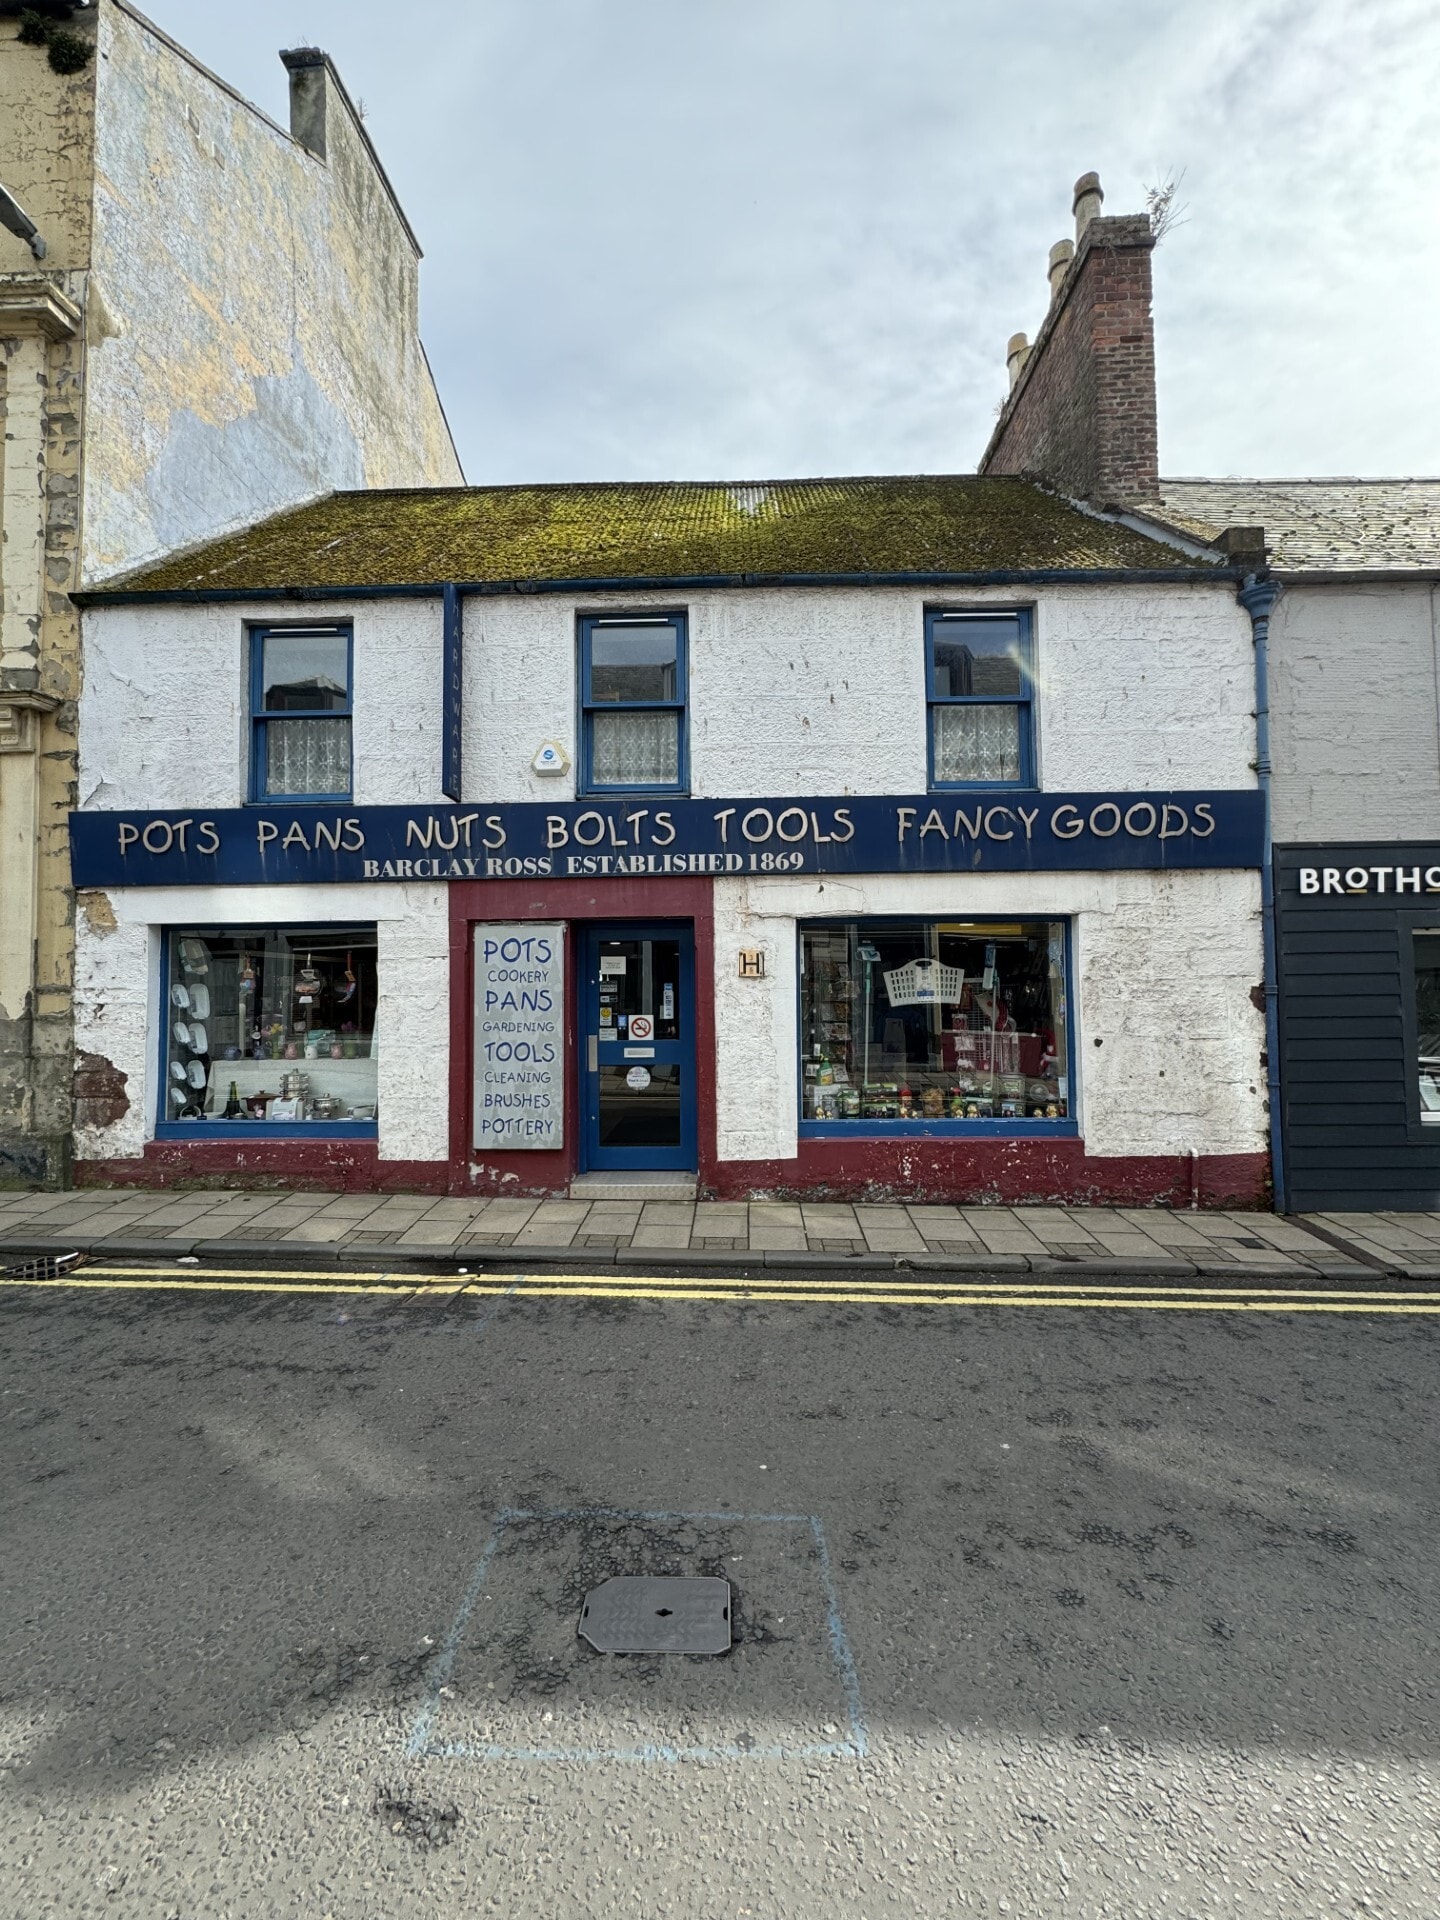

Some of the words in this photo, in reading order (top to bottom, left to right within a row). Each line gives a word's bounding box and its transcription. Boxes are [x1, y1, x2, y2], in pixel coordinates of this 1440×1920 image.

[452, 602, 460, 796] HARDWARE
[117, 819, 220, 855] POTS
[257, 818, 365, 853] PANS
[406, 813, 507, 850] NUTS
[547, 809, 676, 849] BOLTS
[713, 808, 855, 843] TOOLS
[897, 806, 1039, 842] FANCY
[1050, 802, 1215, 839] GOODS
[363, 859, 479, 877] BARCLAY
[486, 856, 551, 876] ROSS
[566, 853, 743, 873] ESTABLISHED
[748, 851, 804, 871] 1869
[484, 937, 552, 963] POTS
[743, 953, 759, 974] H
[487, 969, 549, 984] COOKERY
[485, 989, 553, 1012] PANS
[482, 1021, 555, 1033] GARDENING
[484, 1041, 555, 1063] TOOLS
[484, 1071, 552, 1084] CLEANING
[484, 1093, 551, 1109] BRUSHES
[481, 1117, 554, 1136] POTTERY
